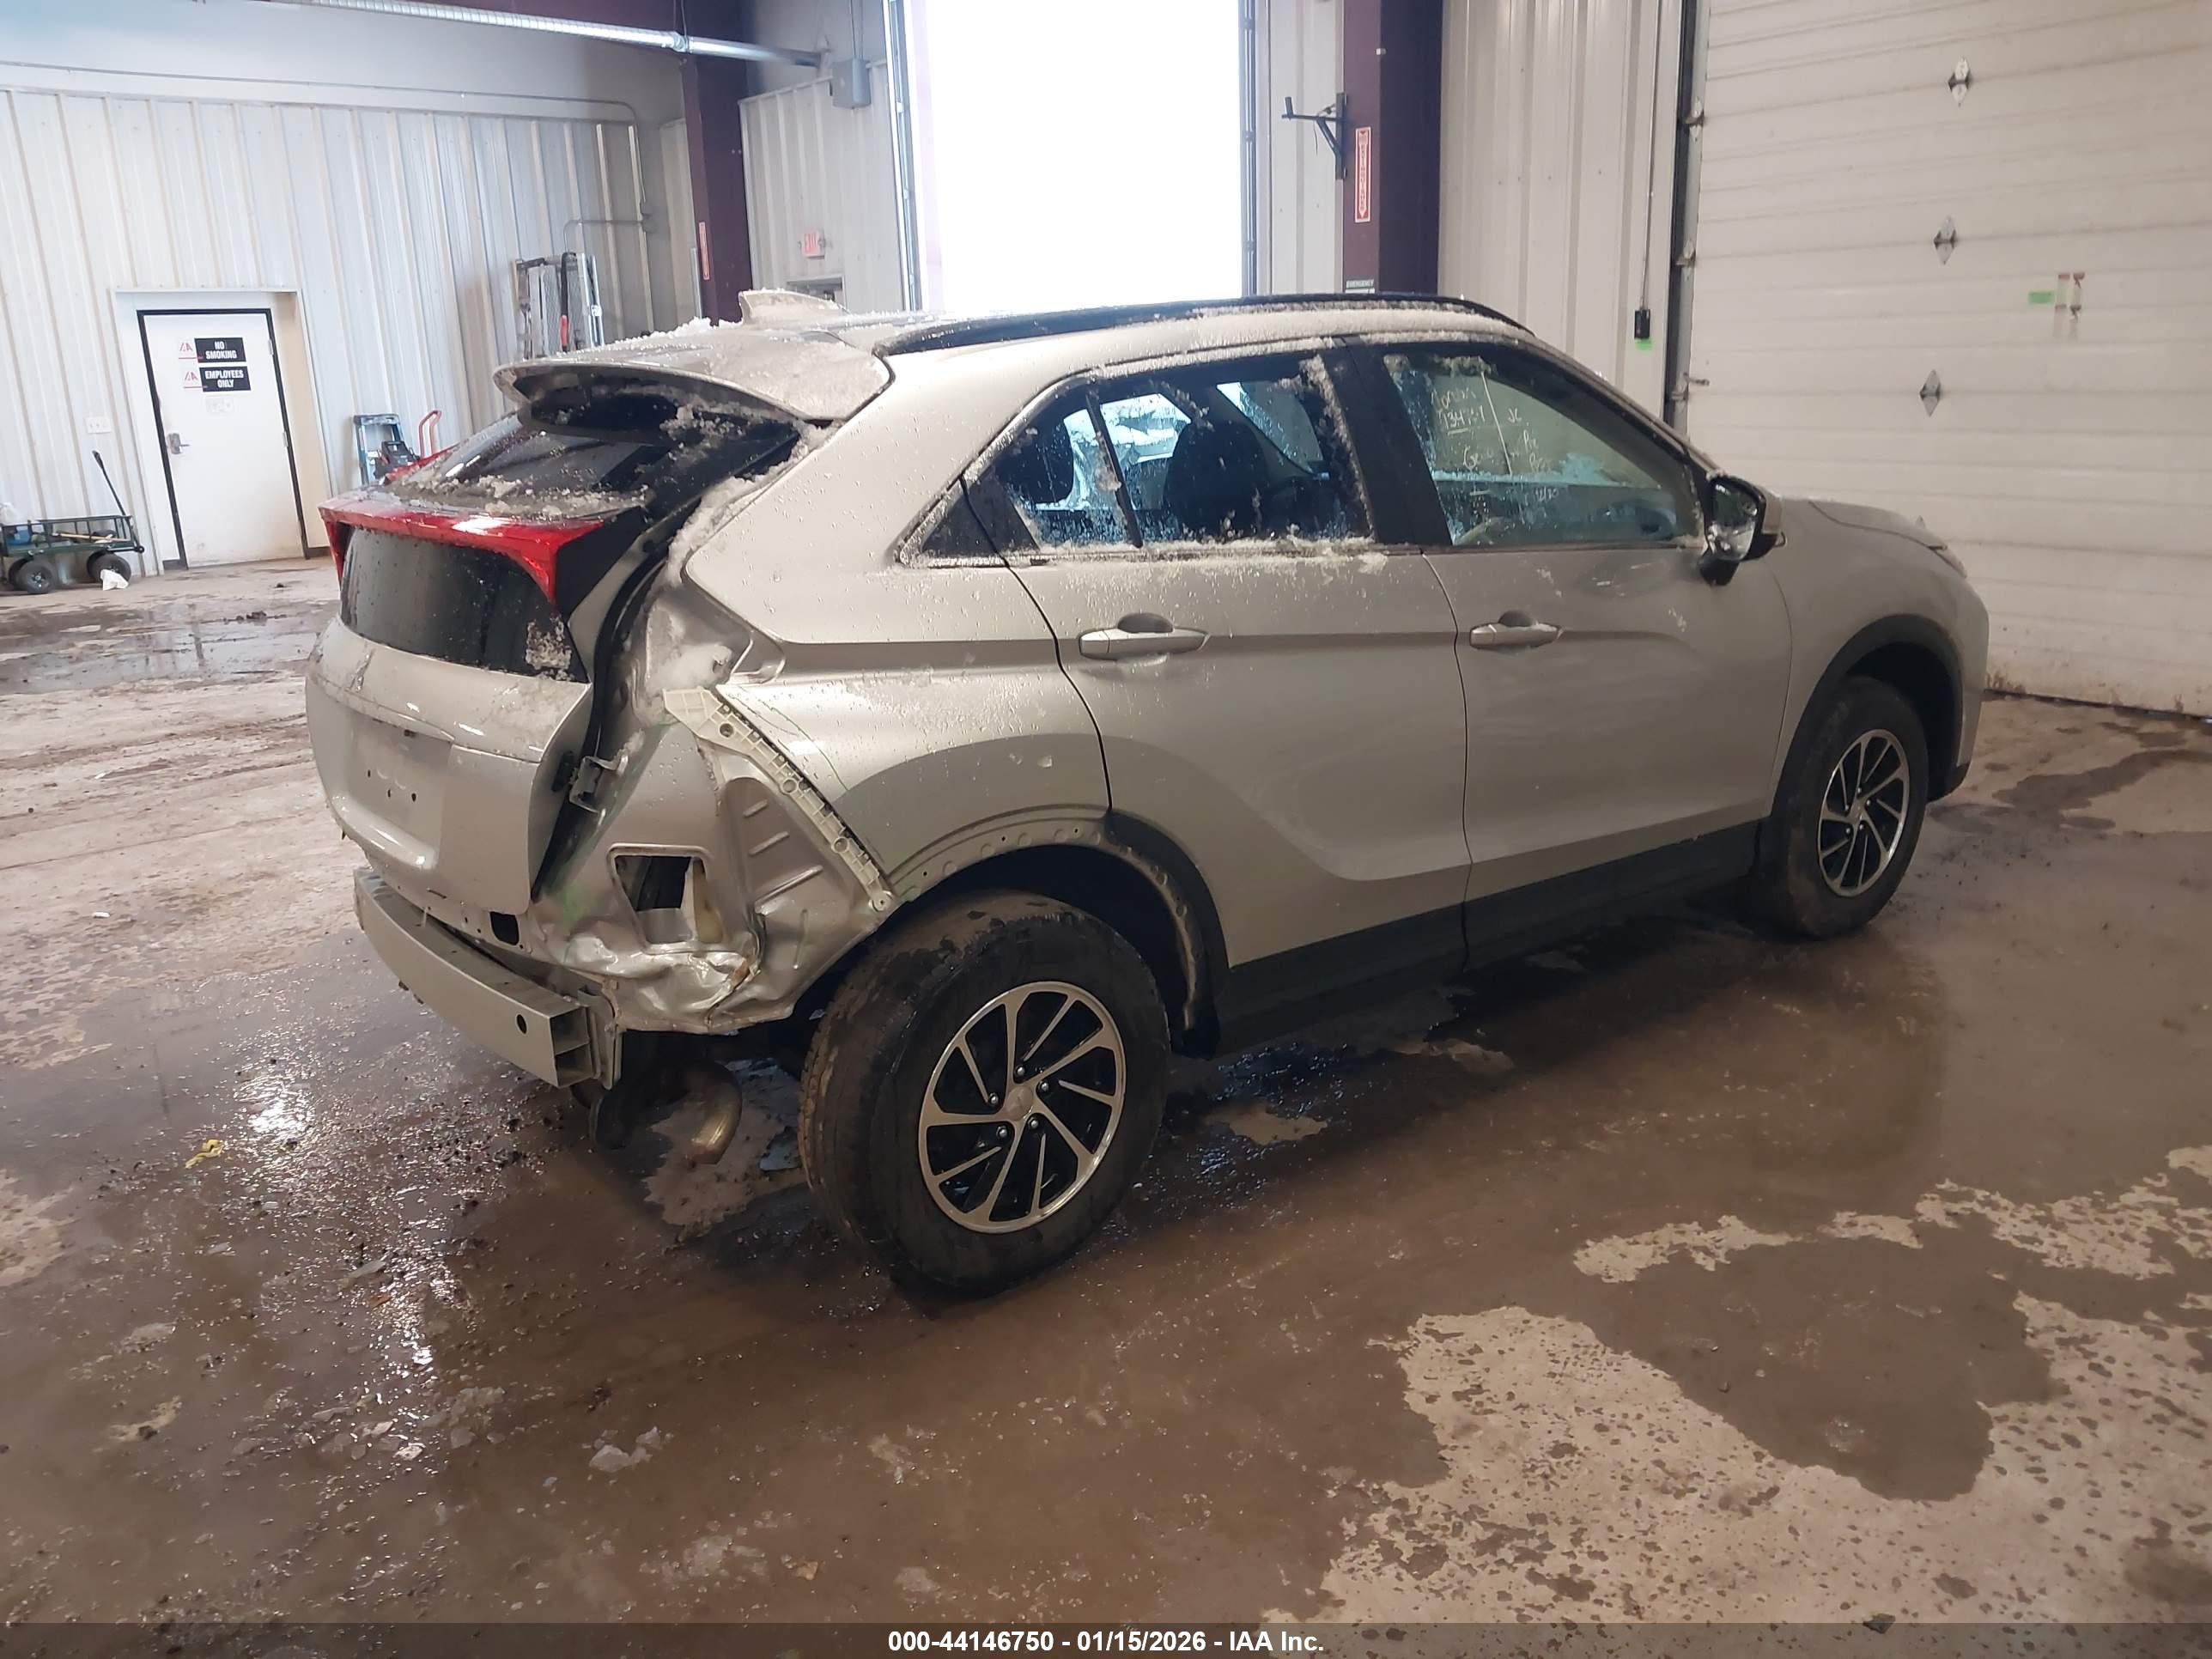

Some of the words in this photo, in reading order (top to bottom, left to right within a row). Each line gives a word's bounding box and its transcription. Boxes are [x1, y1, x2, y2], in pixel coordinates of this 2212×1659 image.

[214, 341, 225, 350] NO
[205, 349, 237, 360] SMOKING
[204, 369, 244, 380] EMPLOYEES
[216, 379, 234, 388] ONLY
